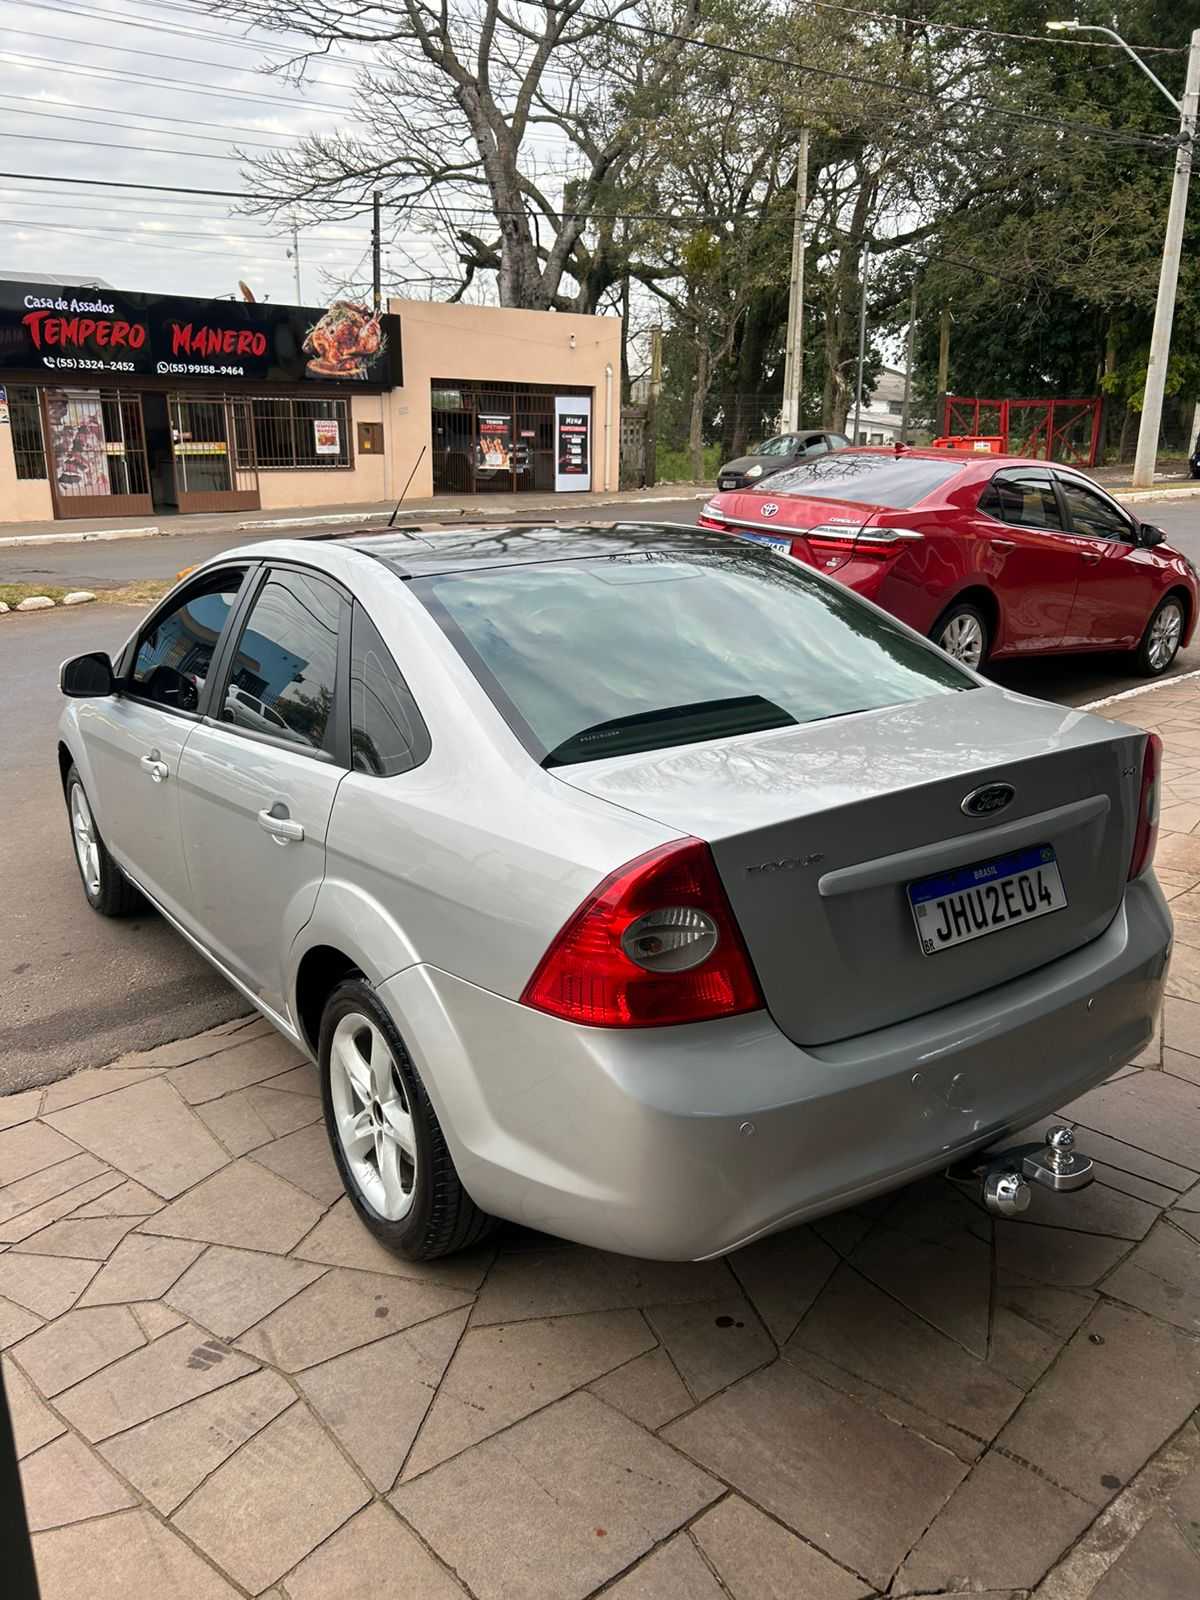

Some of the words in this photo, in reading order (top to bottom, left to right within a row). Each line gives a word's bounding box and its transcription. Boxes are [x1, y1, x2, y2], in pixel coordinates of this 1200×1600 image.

[24, 295, 53, 309] Casa
[55, 297, 68, 311] de
[70, 299, 115, 314] Assados
[22, 310, 145, 351] TEMPERO
[171, 322, 267, 358] MANERO
[57, 357, 77, 369] (55)
[78, 359, 135, 371] 3324-2452
[169, 363, 187, 374] (55)
[188, 364, 244, 375] 99158-9464
[973, 866, 998, 880] BRASIL
[936, 870, 1052, 942] JHU2E04
[923, 938, 936, 952] BR
